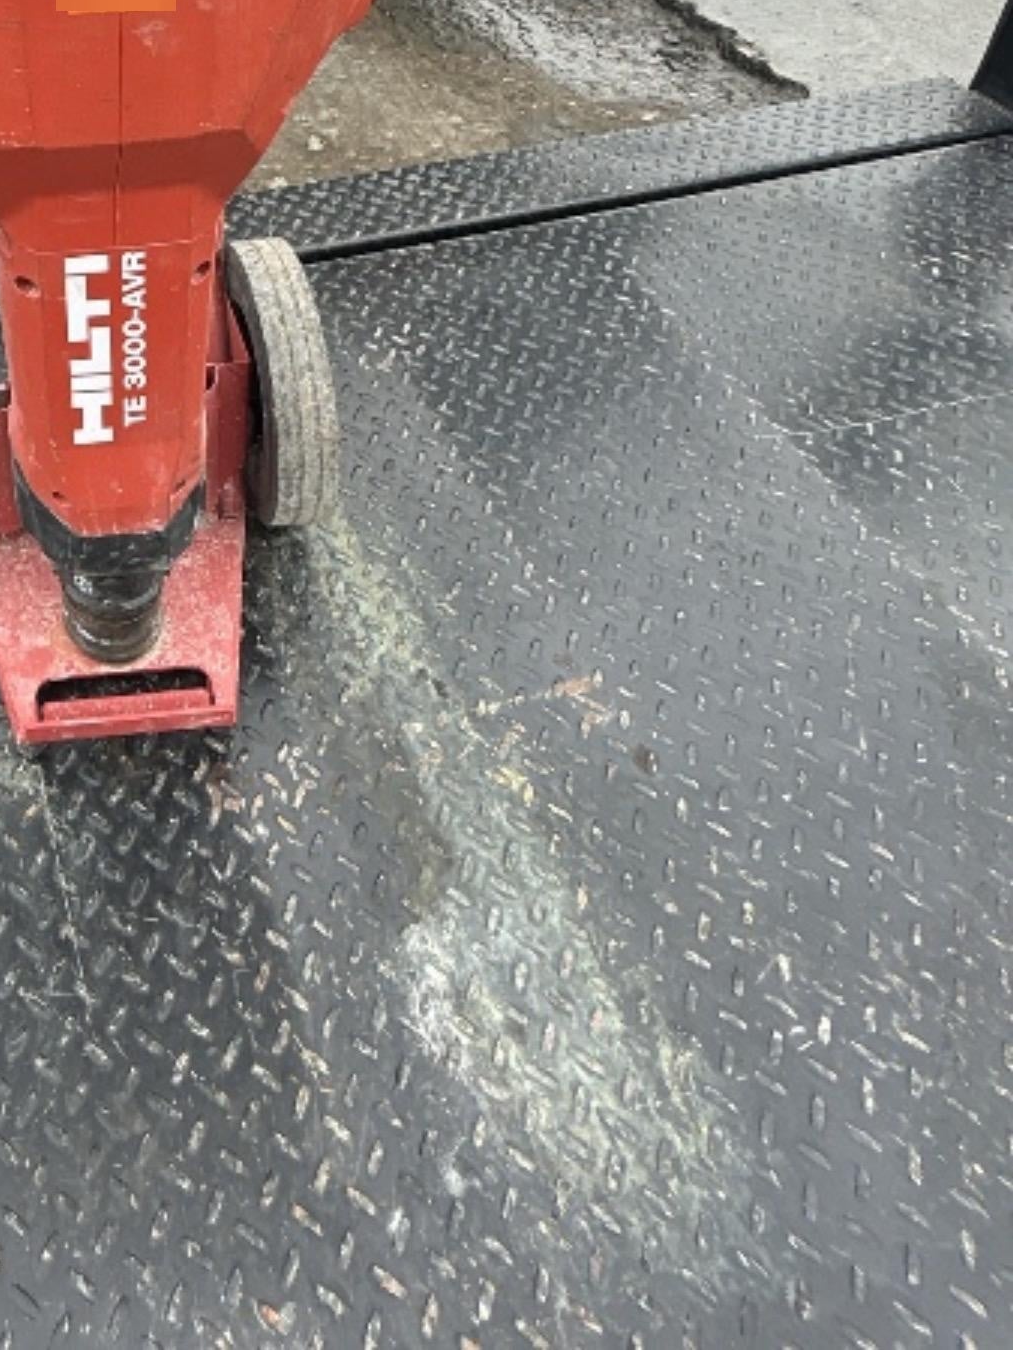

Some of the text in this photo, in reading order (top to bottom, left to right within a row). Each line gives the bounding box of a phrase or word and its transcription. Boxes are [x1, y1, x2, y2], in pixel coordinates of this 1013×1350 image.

[63, 254, 115, 445] HILTI
[121, 250, 148, 428] TE 3000-AVR
